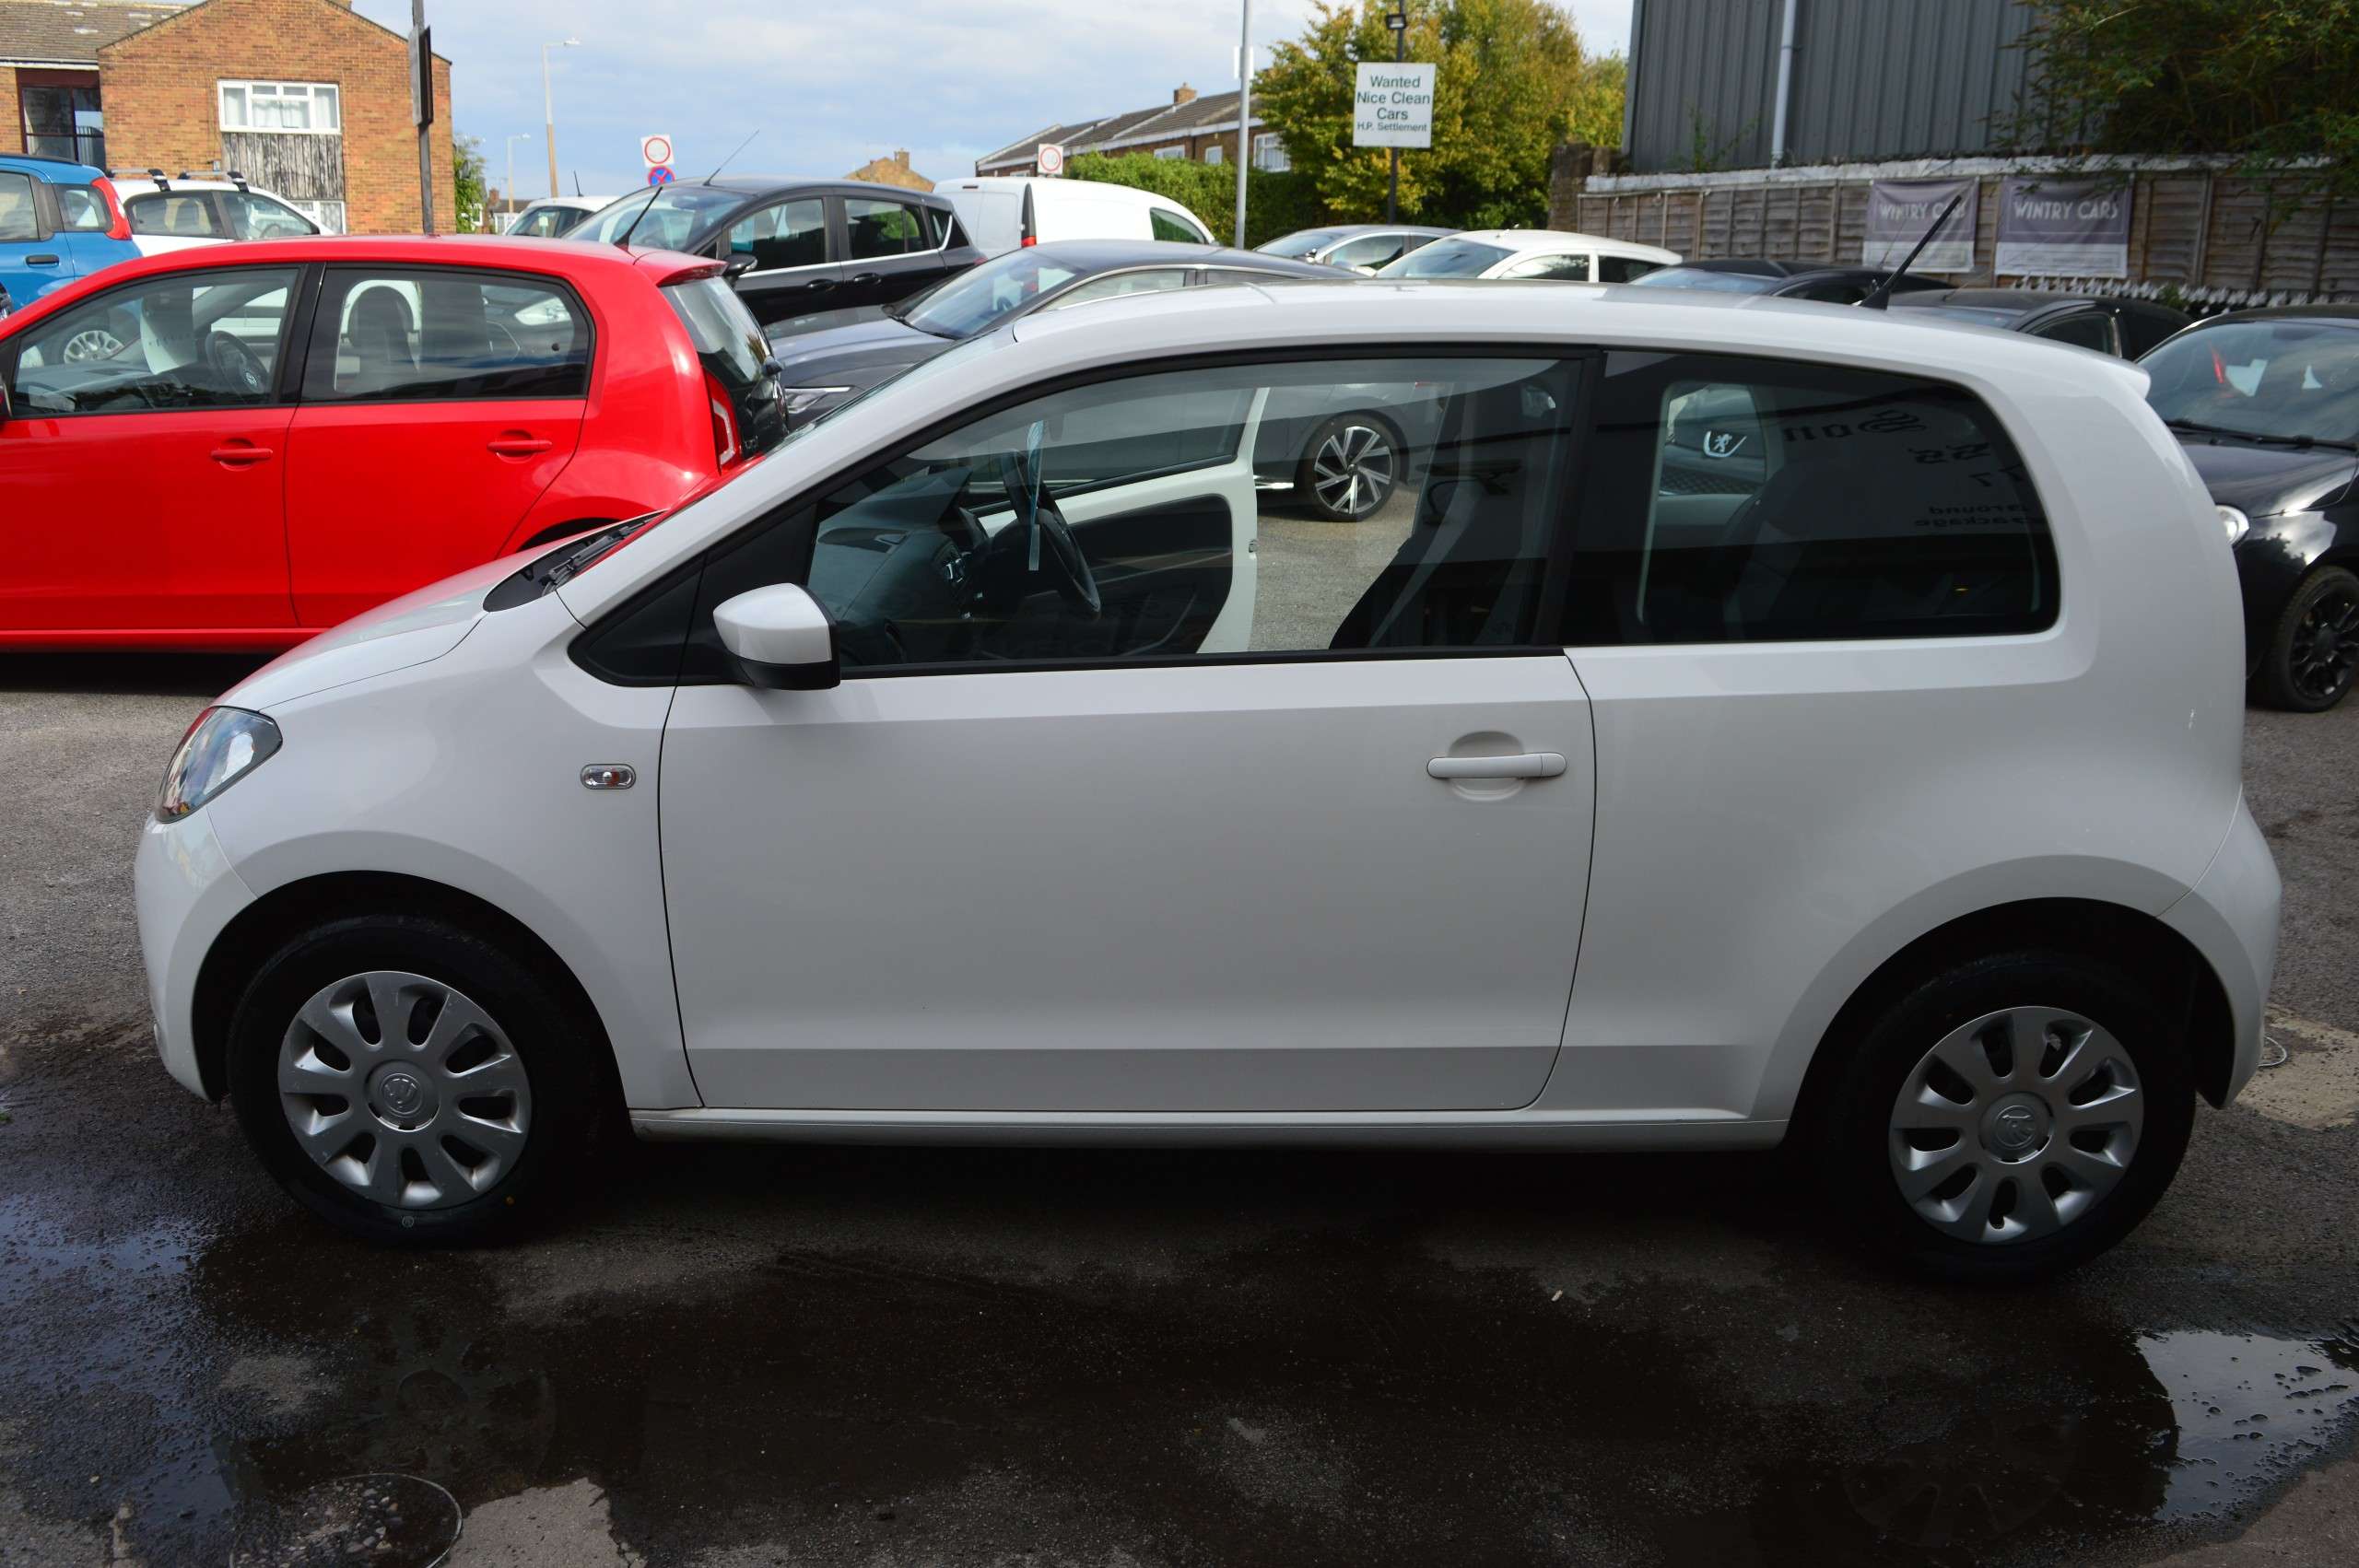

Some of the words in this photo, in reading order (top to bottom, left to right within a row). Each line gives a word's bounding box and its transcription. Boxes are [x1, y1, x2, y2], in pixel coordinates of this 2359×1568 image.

[1370, 75, 1421, 88] Wanted
[1356, 91, 1387, 104] Nice
[1391, 91, 1430, 104] Clean
[1377, 107, 1409, 121] Cars
[1378, 122, 1427, 132] Settlement
[1879, 203, 1929, 220] WINTRY
[2013, 200, 2073, 220] WINTRY
[2077, 200, 2119, 220] CARS
